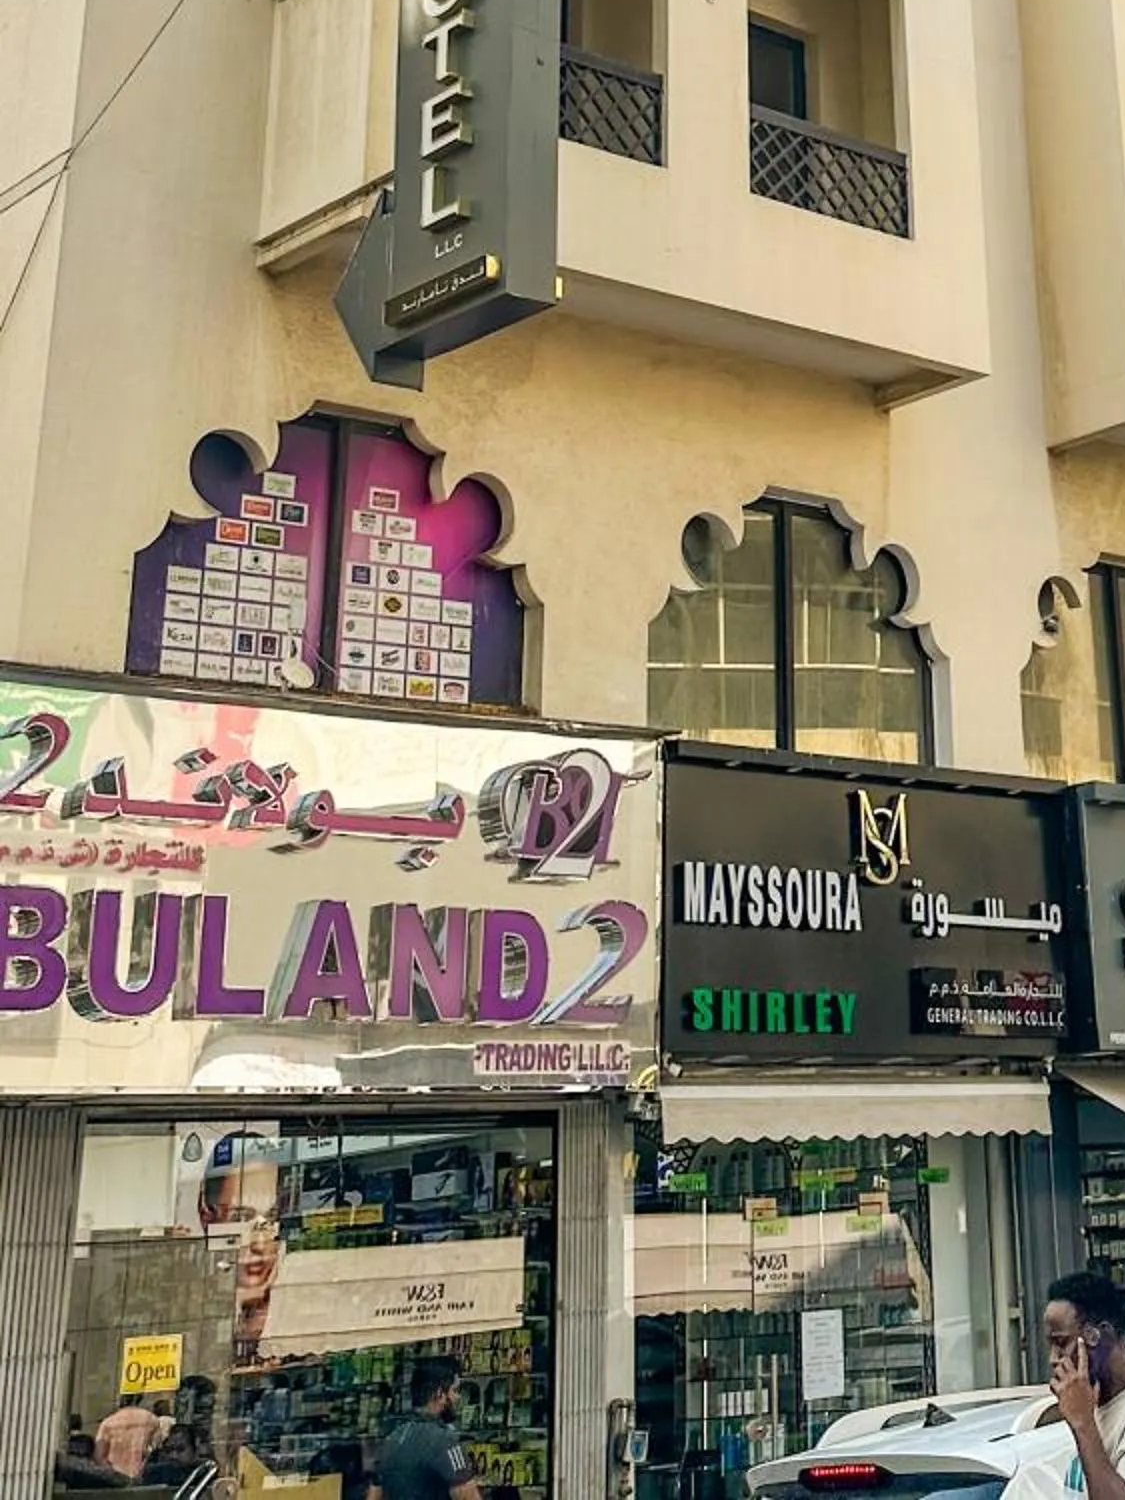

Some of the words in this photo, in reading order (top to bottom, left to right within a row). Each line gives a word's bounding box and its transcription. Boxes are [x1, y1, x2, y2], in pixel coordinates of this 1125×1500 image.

[683, 860, 863, 932] MAYSSOURA
[0, 886, 549, 1028] BULAND
[691, 986, 857, 1034] SHIRLEY
[480, 1042, 572, 1072] TRADING
[126, 1360, 177, 1388] Open
